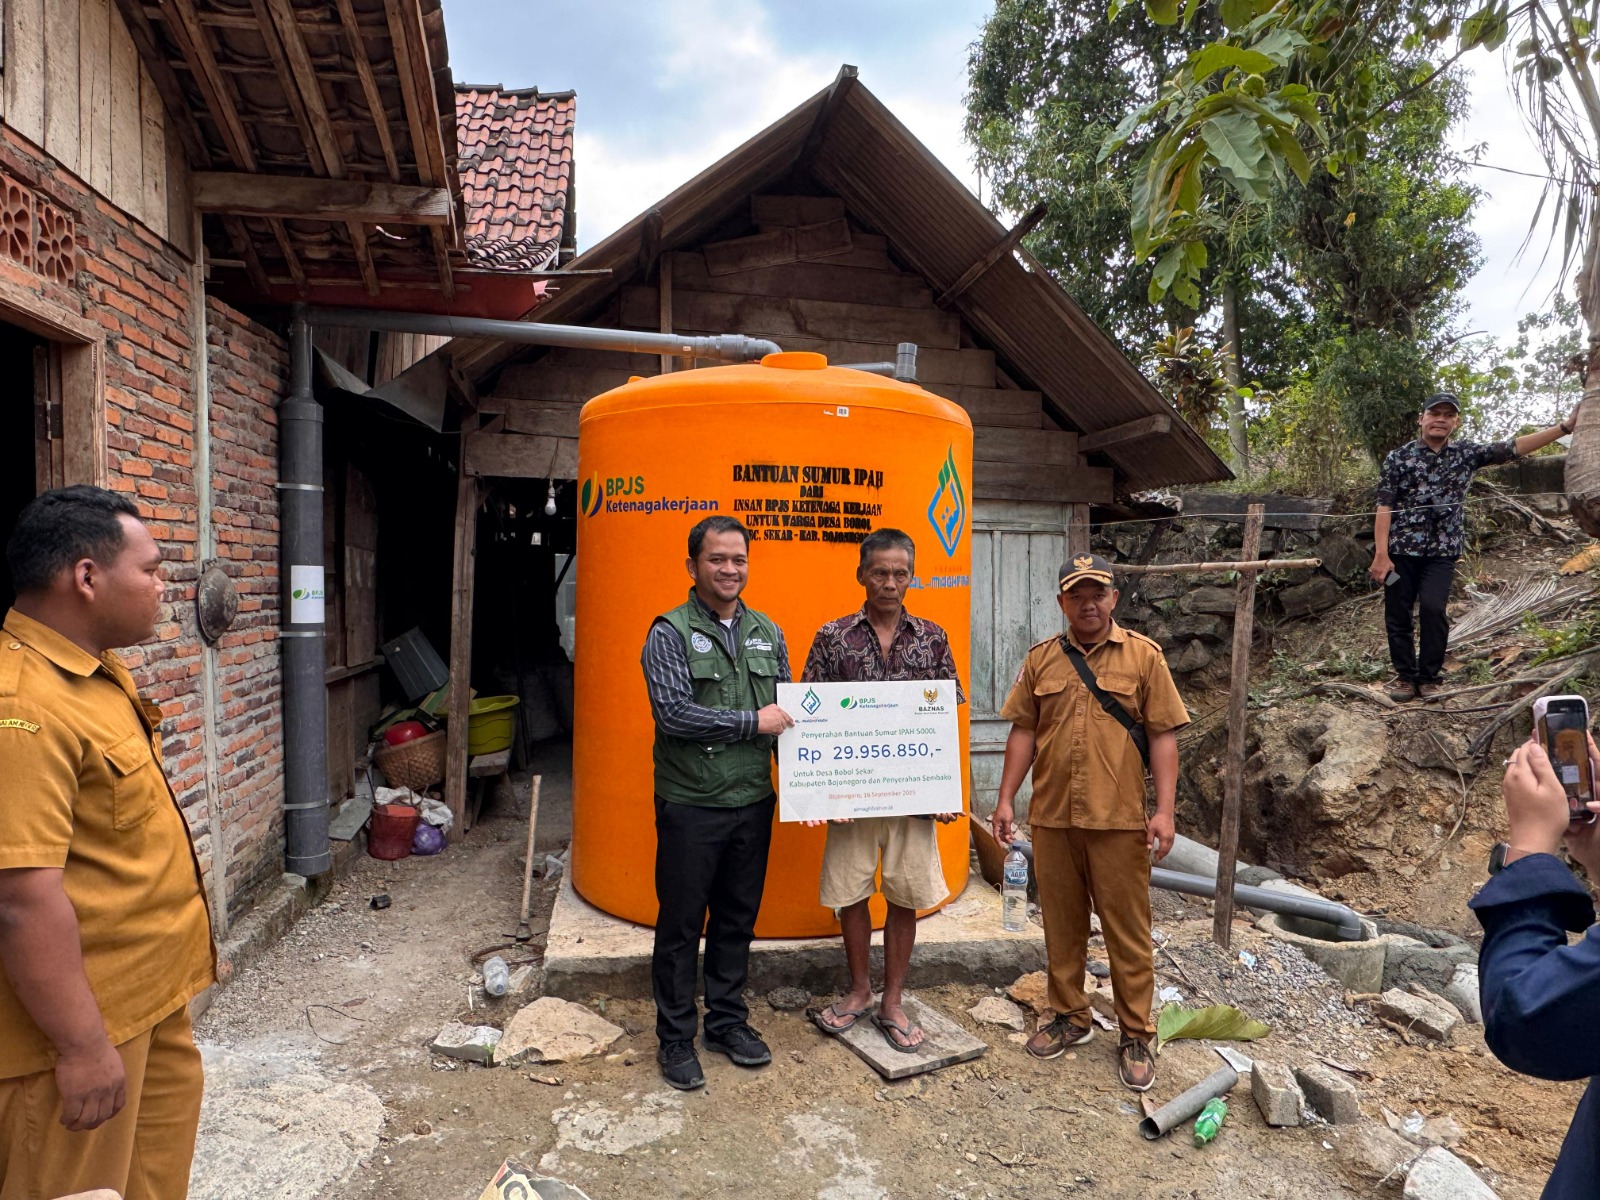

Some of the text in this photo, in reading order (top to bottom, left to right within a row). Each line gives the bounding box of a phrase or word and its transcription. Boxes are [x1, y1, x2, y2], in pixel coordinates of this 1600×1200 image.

[733, 464, 884, 487] BANTUAN SUMUR IPAH
[605, 475, 645, 497] BPJS
[800, 485, 824, 498] DARI
[605, 496, 719, 515] Ketenagakerjaan
[733, 499, 883, 516] INSAN BPJS KETENAGA KERJAAN
[746, 514, 780, 527] UNTUK
[782, 515, 816, 528] WARGA
[817, 516, 841, 528] DESA
[764, 529, 793, 541] SEKAR
[801, 731, 843, 740] Penyerahan
[844, 730, 873, 738] Bantuan
[798, 742, 942, 764] Rp 29.956.850,-
[816, 769, 833, 777] Desa
[834, 768, 854, 776] Bobol
[789, 780, 826, 788] Kabupaten
[828, 778, 867, 787] Bojonegoro
[882, 775, 921, 784] Penyerahan
[922, 774, 952, 782] Sembako
